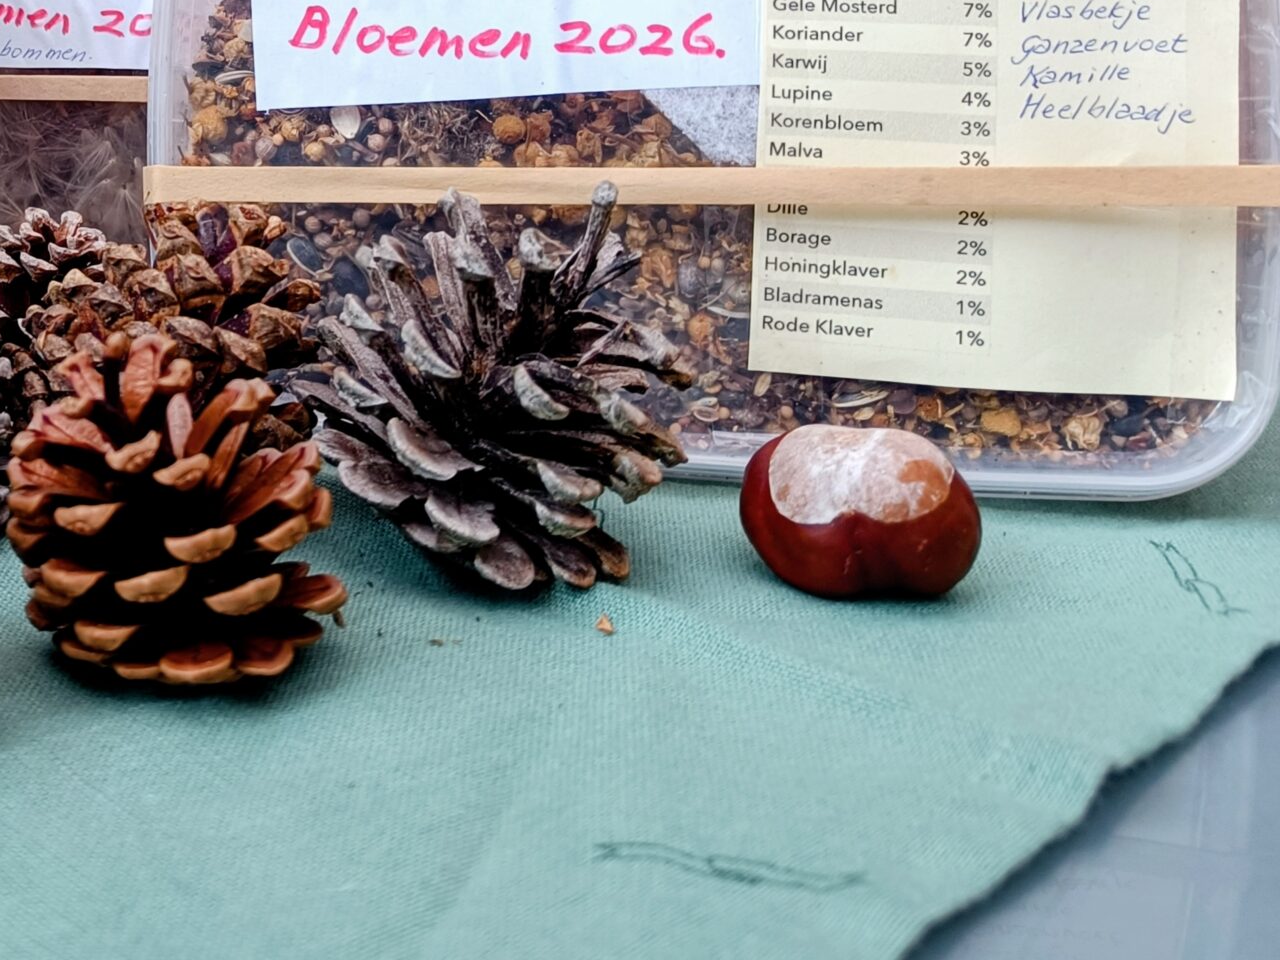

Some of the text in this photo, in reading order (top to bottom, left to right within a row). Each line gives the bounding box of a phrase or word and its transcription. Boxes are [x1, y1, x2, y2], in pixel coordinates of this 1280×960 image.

[964, 2, 993, 18] 7%
[288, 5, 726, 60] Bloemen 2026.
[772, 24, 993, 49] Koriander 7%
[772, 53, 992, 78] Karwij 5%
[1020, 64, 1130, 89] Kamille
[771, 84, 992, 108] Lupine 4%
[770, 112, 991, 138] Korenbloem 3%
[1020, 93, 1196, 135] Heelblaadje
[769, 142, 990, 167] Malva 3%
[958, 210, 988, 227] 2%
[766, 228, 988, 257] Borage 2%
[764, 256, 987, 287] Honingklaver 2%
[764, 286, 986, 317] Bladramenas 1%
[762, 316, 985, 347] Rode Klaver 1%
